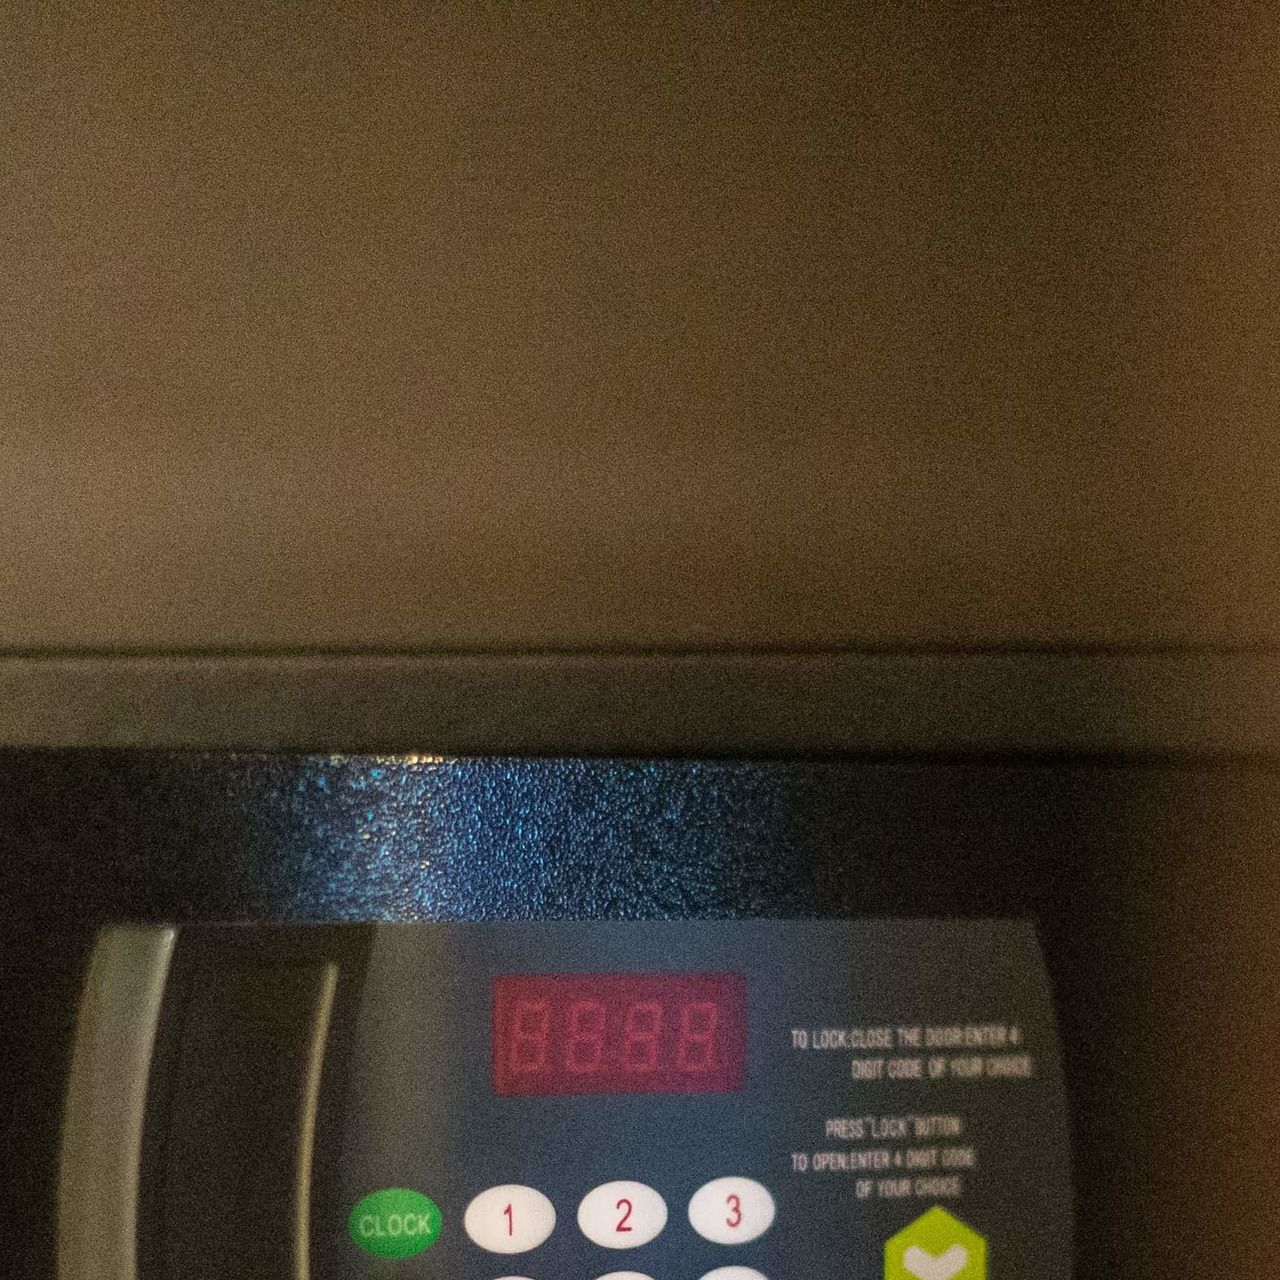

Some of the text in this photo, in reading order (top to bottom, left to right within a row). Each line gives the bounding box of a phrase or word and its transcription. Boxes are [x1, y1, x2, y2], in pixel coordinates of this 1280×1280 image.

[791, 1029, 808, 1049] TO
[897, 1026, 921, 1047] THE
[851, 1058, 884, 1079] DIGIT
[887, 1057, 922, 1079] CODE
[927, 1056, 946, 1078] OF
[949, 1055, 982, 1078] YOUR
[825, 1118, 864, 1138] PRESS
[915, 1115, 961, 1137] BUTTON
[791, 1152, 808, 1172] TO
[905, 1148, 938, 1169] DIGIT
[941, 1146, 975, 1168] CODE
[854, 1179, 873, 1200] OF
[877, 1177, 912, 1198] YOUR
[503, 1203, 514, 1236] 1
[615, 1198, 633, 1233] 2
[725, 1194, 742, 1228] 3
[360, 1213, 432, 1238] CLOCK
